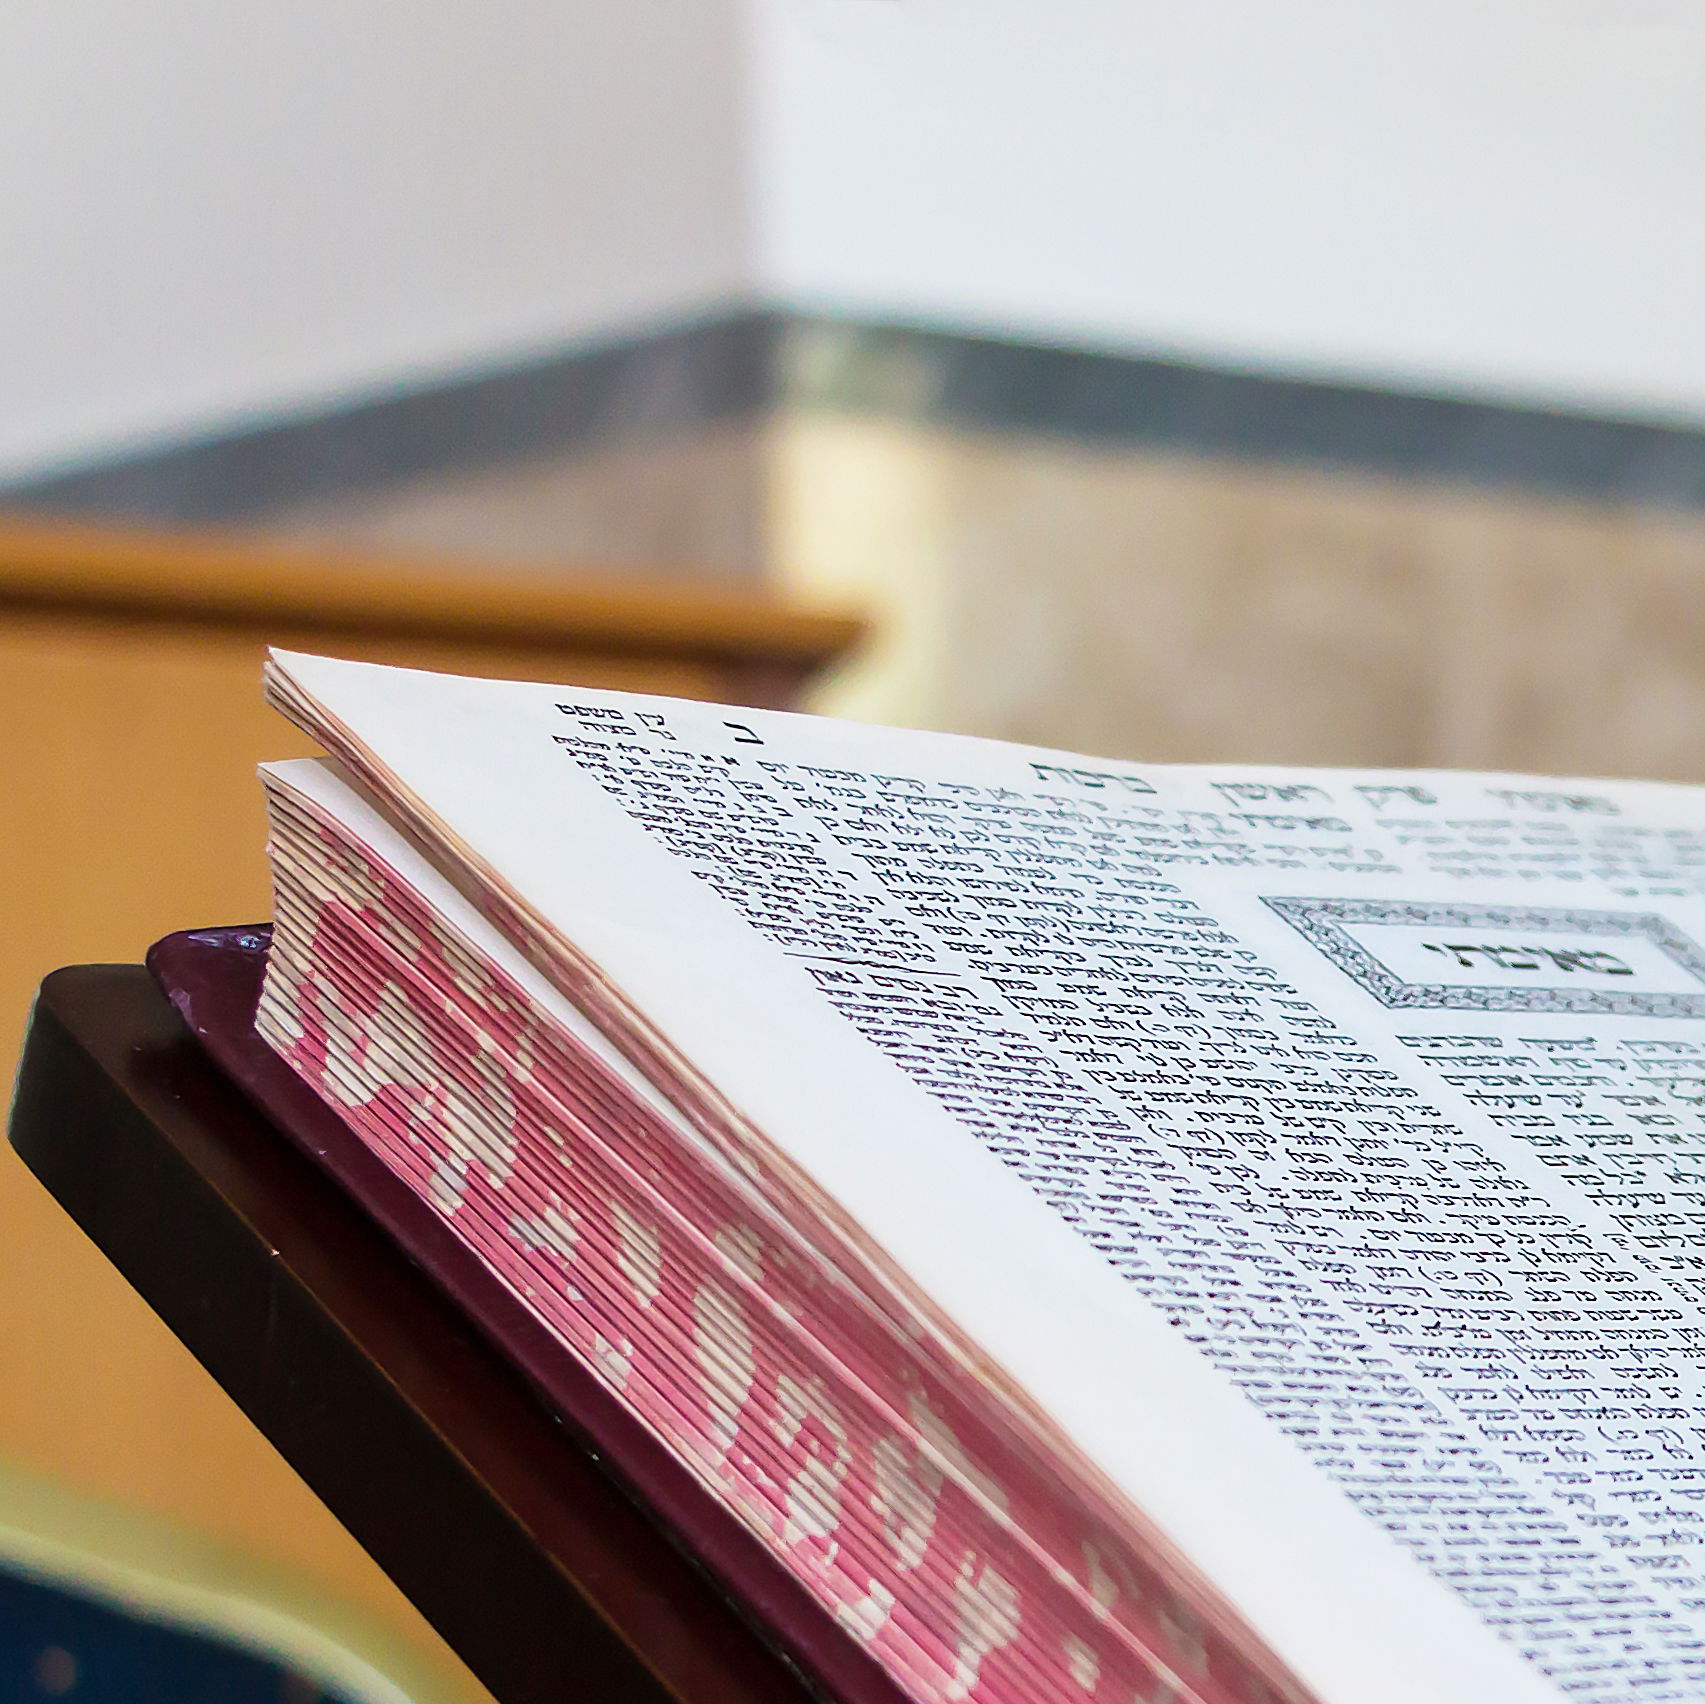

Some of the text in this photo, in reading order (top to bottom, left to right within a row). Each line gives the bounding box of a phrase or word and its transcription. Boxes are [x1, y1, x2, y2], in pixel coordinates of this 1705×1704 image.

[554, 702, 665, 727] עין משפט
[577, 720, 678, 742] נר מצוה
[721, 720, 766, 746] ב
[1028, 762, 1158, 794] ברכות
[1420, 941, 1637, 977] מאימתי
[803, 966, 980, 1000] רב נסים גאון
[1608, 1213, 1687, 1233] מצותן
[1403, 1229, 1475, 1244] מבעוד
[1474, 1232, 1507, 1248] כך
[1503, 1229, 1536, 1245] כל
[1397, 1248, 1457, 1262] יהודה
[1459, 1250, 1512, 1263] כרבי
[1517, 1247, 1542, 1268] לן
[1507, 1270, 1571, 1283] השחר
[1579, 1267, 1639, 1283] תפלת
